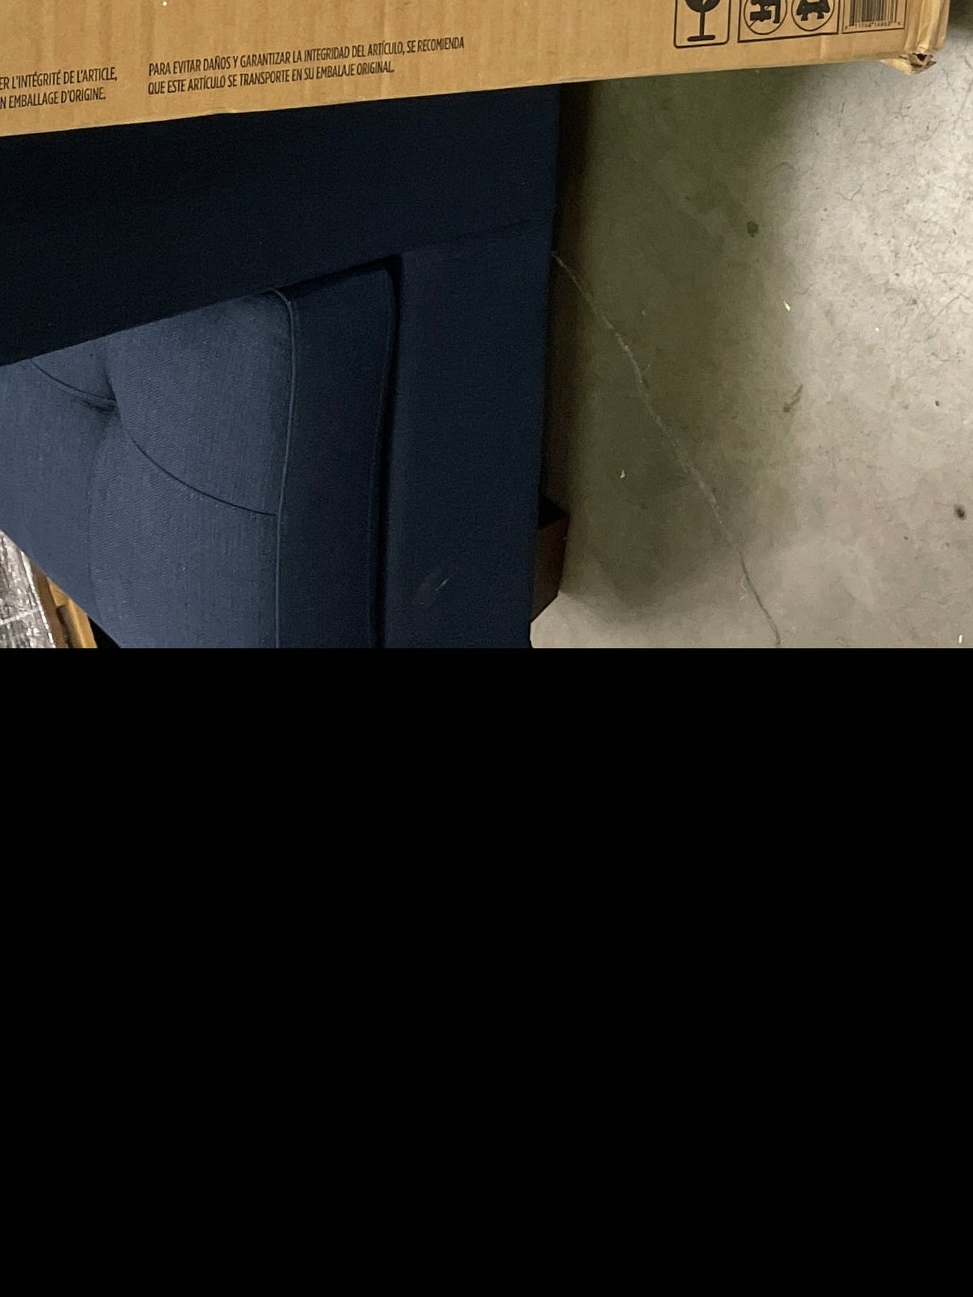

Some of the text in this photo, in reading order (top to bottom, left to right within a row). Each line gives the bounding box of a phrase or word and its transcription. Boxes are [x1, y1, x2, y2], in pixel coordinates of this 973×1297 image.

[148, 61, 171, 76] PARA
[173, 58, 201, 74] EVITAR
[203, 55, 231, 71] DAÑOS
[240, 51, 290, 68] GARANTIZAR
[293, 50, 301, 63] LA
[304, 45, 349, 61] INTEGRIDAD
[352, 44, 365, 57] DEL
[367, 41, 404, 56] ARTÍCULO,
[407, 40, 415, 53] SE
[417, 36, 464, 52] RECOMIENDA
[12, 71, 60, 89] L'INTÉGRITÉ
[63, 70, 74, 84] DE
[77, 67, 117, 83] L'ARTICLE,
